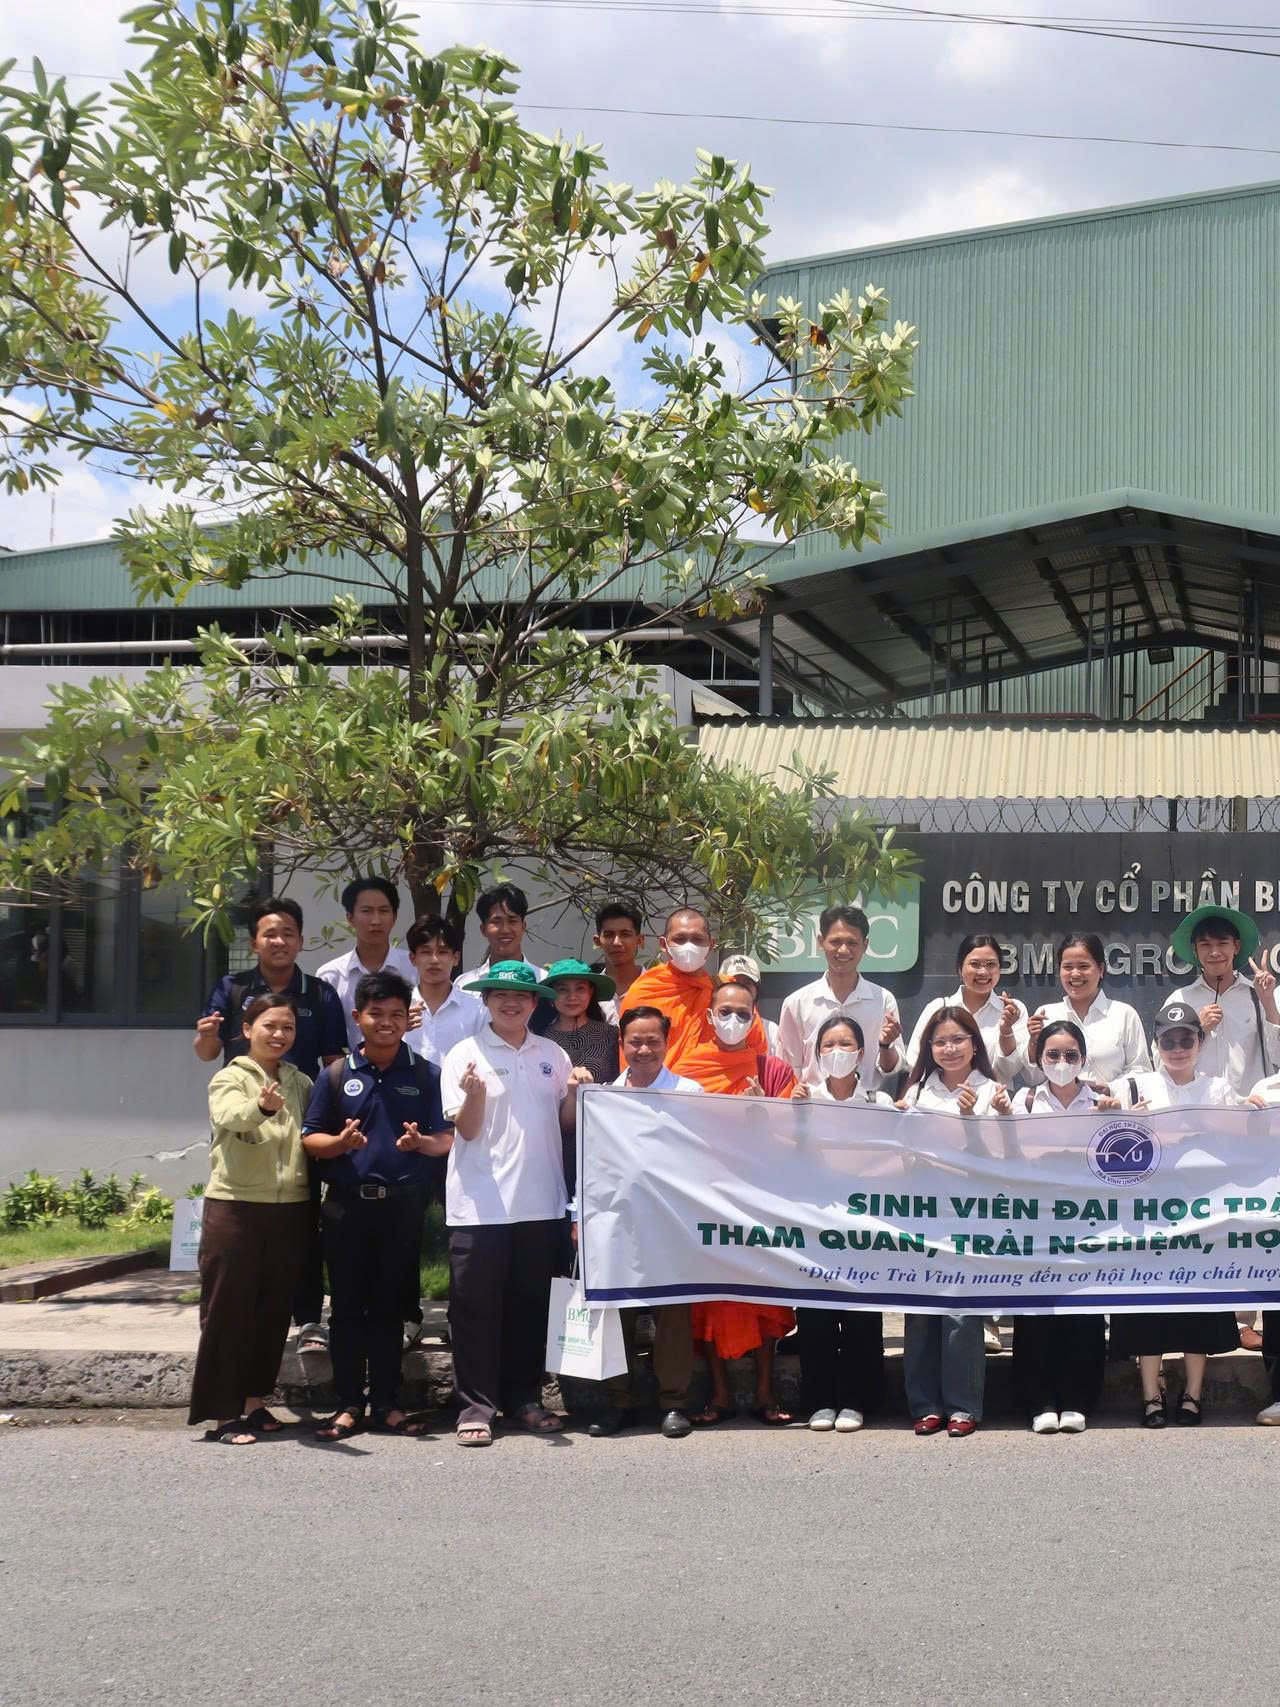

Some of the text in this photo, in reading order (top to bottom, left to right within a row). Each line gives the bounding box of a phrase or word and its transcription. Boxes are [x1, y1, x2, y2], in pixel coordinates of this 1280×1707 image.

[942, 872, 1030, 913] CÔNG
[1042, 880, 1084, 913] TY
[1095, 862, 1142, 914] CỔ
[1151, 867, 1240, 913] PHẦN
[847, 1192, 938, 1218] SINH
[950, 1193, 1039, 1220] VIÊN
[1052, 1199, 1118, 1227] ĐẠI
[1133, 1198, 1210, 1227] HỌC
[697, 1222, 806, 1249] THAM
[818, 1228, 938, 1258] QUAN,
[951, 1228, 1034, 1256] TRẢI
[847, 1266, 879, 1282] học
[887, 1267, 917, 1283] Trà
[924, 1270, 966, 1285] Vinh
[971, 1273, 1023, 1287] mang
[1029, 1266, 1062, 1284] đến
[1068, 1271, 1091, 1283] cơ
[1096, 1267, 1126, 1284] hội
[1130, 1267, 1163, 1283] học
[1169, 1266, 1197, 1285] tập
[1202, 1262, 1242, 1280] chất
